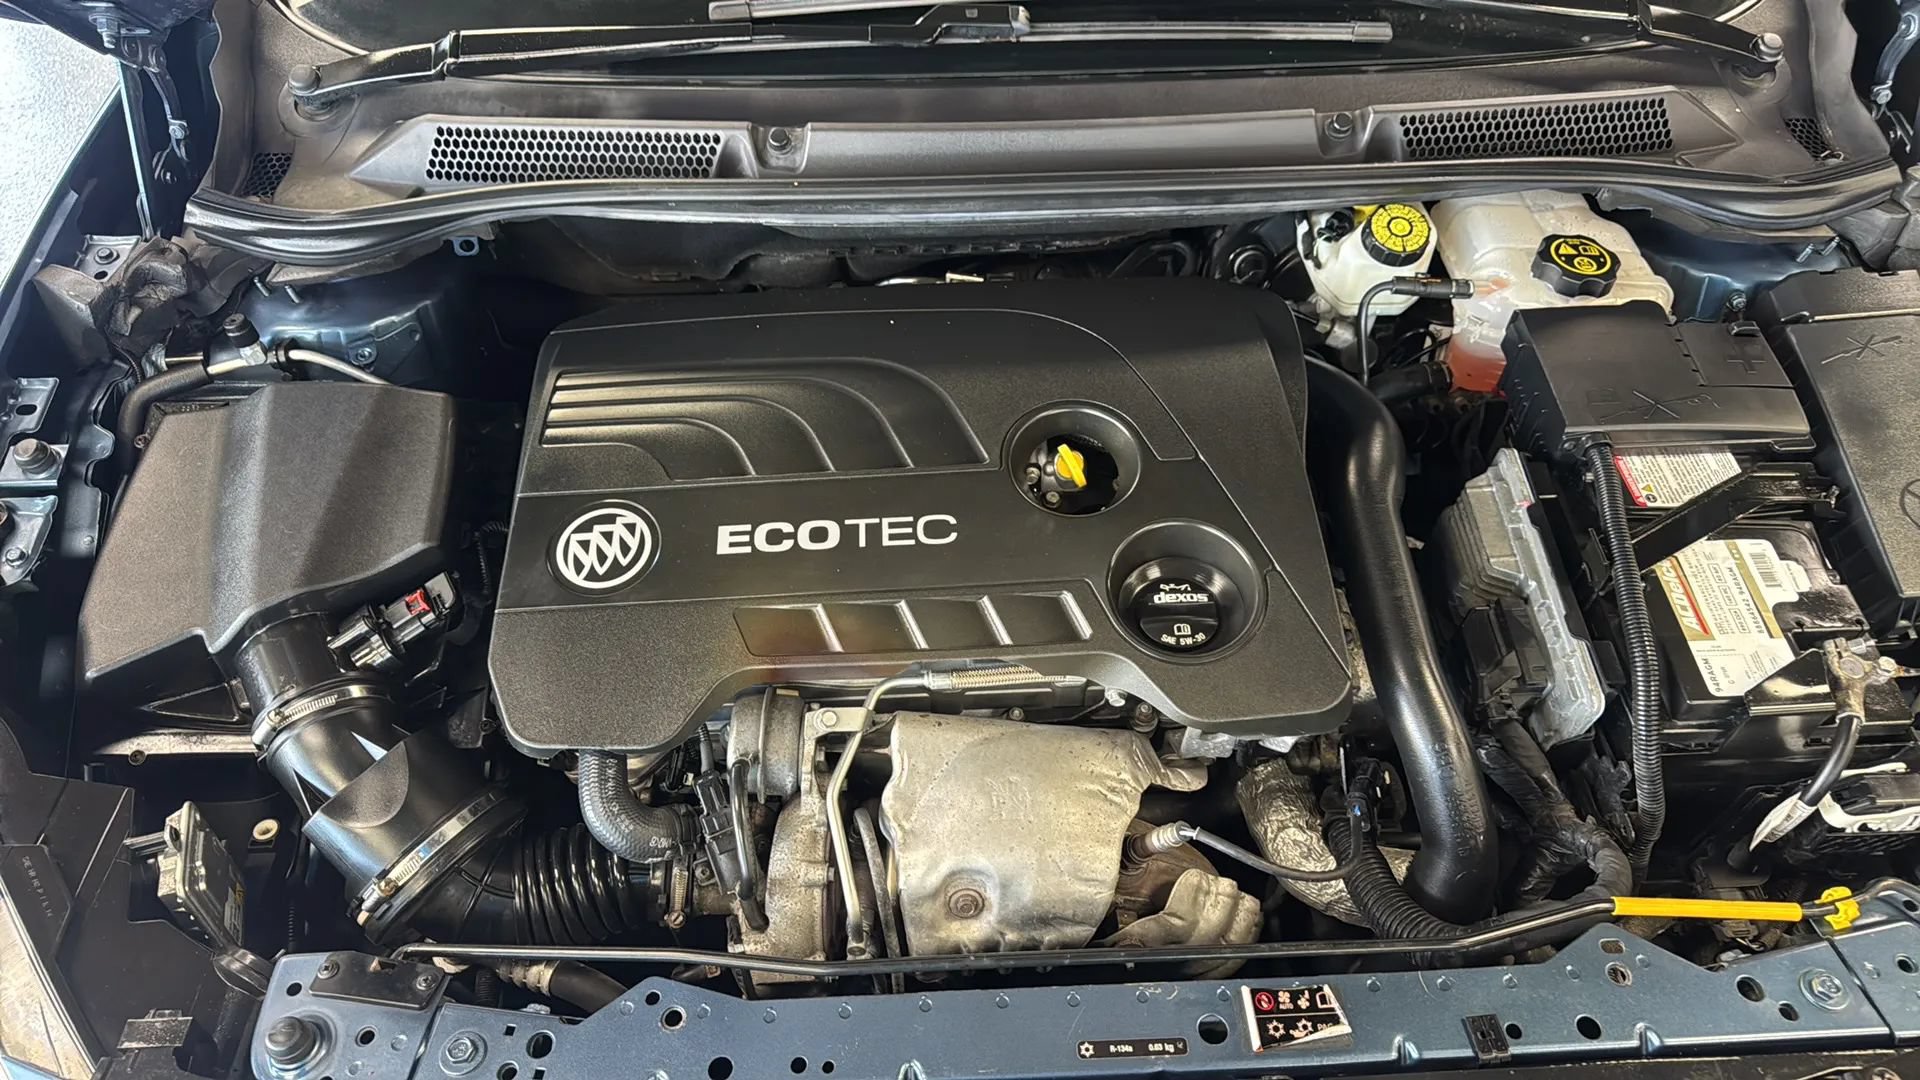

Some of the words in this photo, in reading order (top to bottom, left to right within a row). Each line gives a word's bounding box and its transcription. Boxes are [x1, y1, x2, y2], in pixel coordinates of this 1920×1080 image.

[716, 514, 958, 555] ECOTEC
[1153, 592, 1209, 604] dexos
[1160, 633, 1177, 645] SAE
[1179, 632, 1206, 645] 5W-30
[1701, 657, 1724, 693] 94RAGM
[1279, 1002, 1294, 1010] AUTO
[1109, 1044, 1134, 1053] R-134a
[1164, 1042, 1175, 1053] kg
